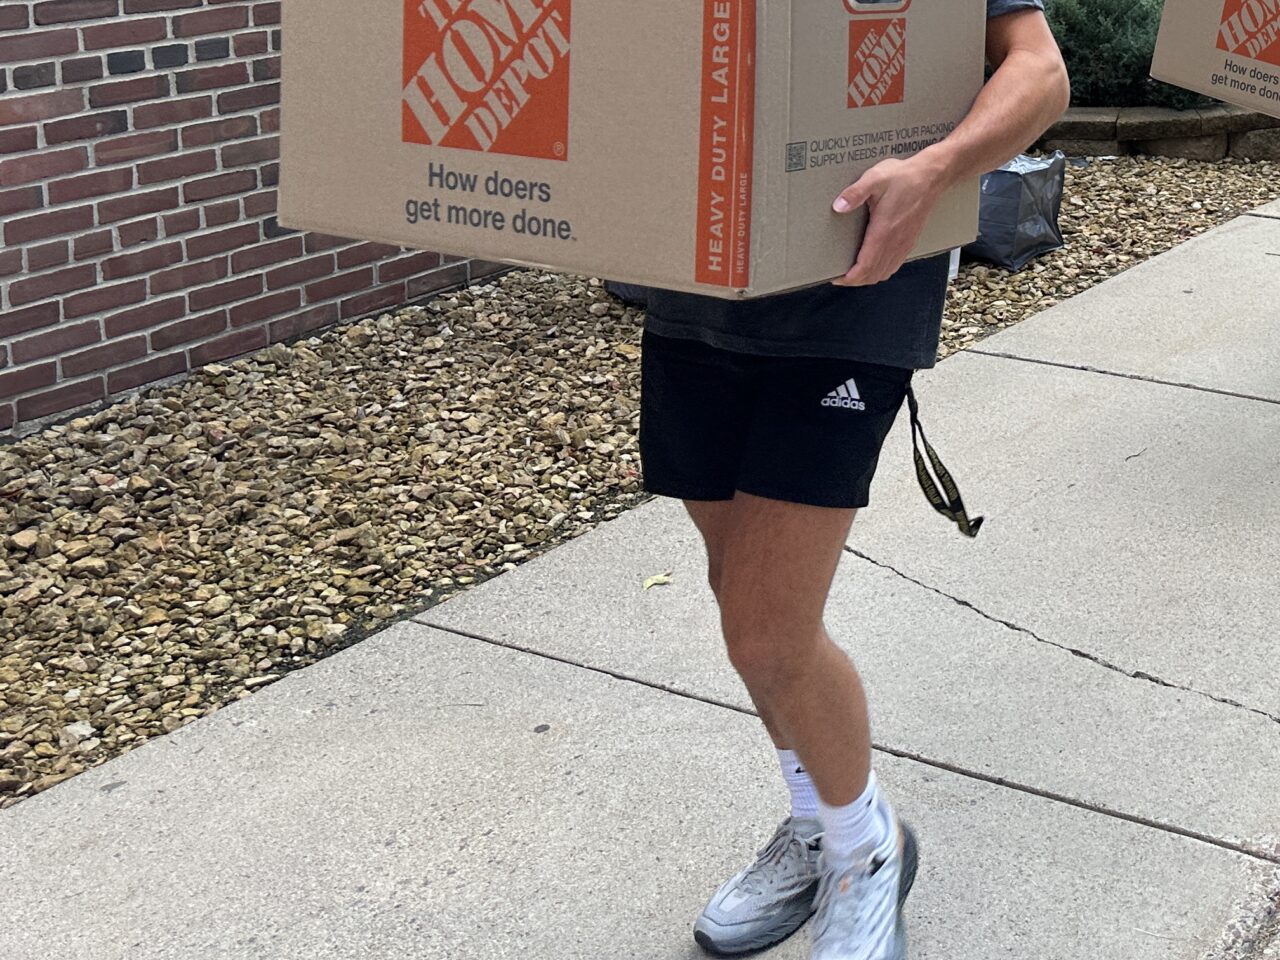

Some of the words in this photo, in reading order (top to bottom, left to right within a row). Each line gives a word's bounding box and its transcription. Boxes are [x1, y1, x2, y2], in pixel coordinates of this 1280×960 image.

[712, 0, 731, 104] LARGE
[847, 18, 907, 107] HOME
[854, 28, 880, 63] THE
[464, 9, 570, 152] DEPOT
[869, 49, 905, 106] DEPOT
[1211, 73, 1228, 85] get
[1230, 78, 1257, 94] more
[1224, 59, 1248, 76] How
[1250, 67, 1280, 85] doers
[711, 115, 727, 181] DUTY
[810, 135, 851, 153] QUICKLY
[852, 130, 894, 147] ESTIMATE
[895, 126, 919, 140] YOUR
[920, 121, 956, 138] PACKING
[810, 151, 847, 168] SUPPLY
[848, 147, 877, 161] NEEDS
[878, 144, 890, 157] AT
[428, 162, 478, 193] How
[485, 170, 551, 203] doers
[405, 198, 441, 224] get
[447, 203, 506, 231] more
[512, 209, 577, 241] done.
[708, 191, 725, 271] HEAVY
[738, 210, 747, 237] DUTY
[736, 239, 746, 273] HEAVY
[821, 397, 865, 410] adidas
